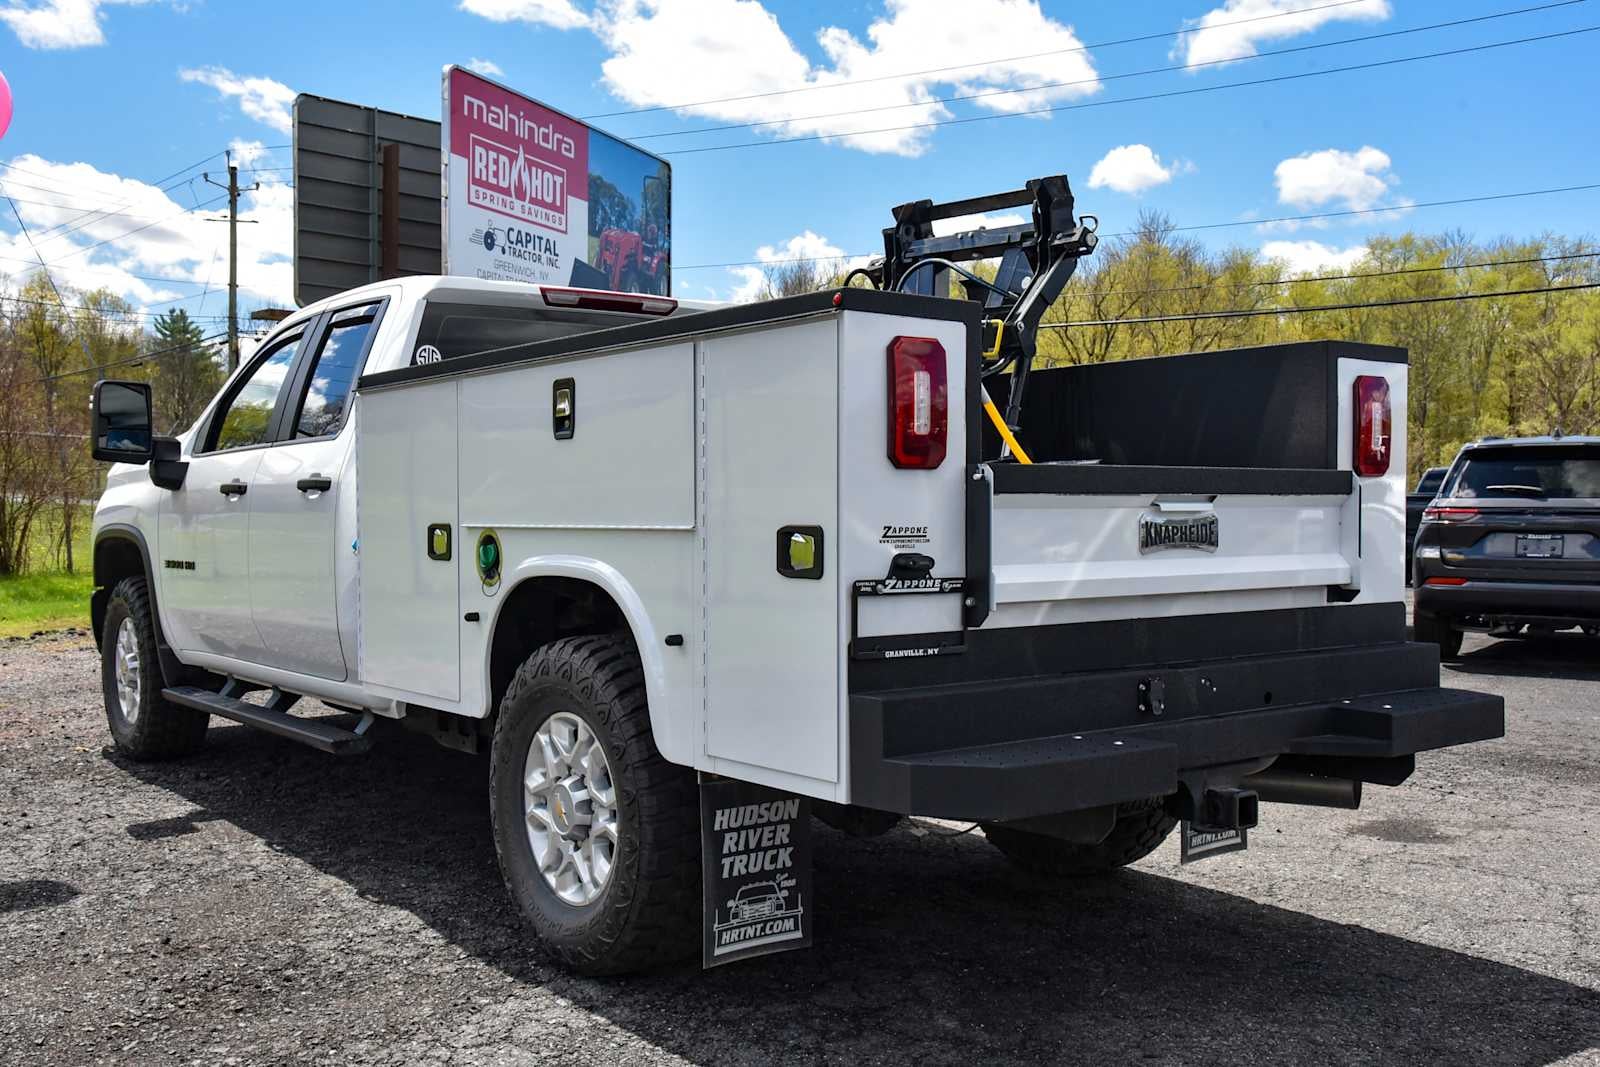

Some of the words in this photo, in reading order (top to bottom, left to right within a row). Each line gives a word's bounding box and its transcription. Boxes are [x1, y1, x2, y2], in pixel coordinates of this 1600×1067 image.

[463, 94, 575, 159] mahindra
[474, 145, 509, 188] RED
[531, 168, 564, 207] HOT
[474, 189, 515, 211] SPRING
[521, 203, 564, 227] SAVINGS
[507, 227, 559, 257] CAPITAL
[881, 525, 929, 539] ZAPPONE
[1144, 519, 1216, 549] KNAPHEIDE
[885, 579, 941, 591] ZAPPONE
[928, 647, 939, 655] NY
[713, 799, 800, 831] HUDSON
[722, 823, 791, 854] RIVER
[721, 846, 794, 879] TRUCK
[720, 917, 795, 945] HRTNT.COM
